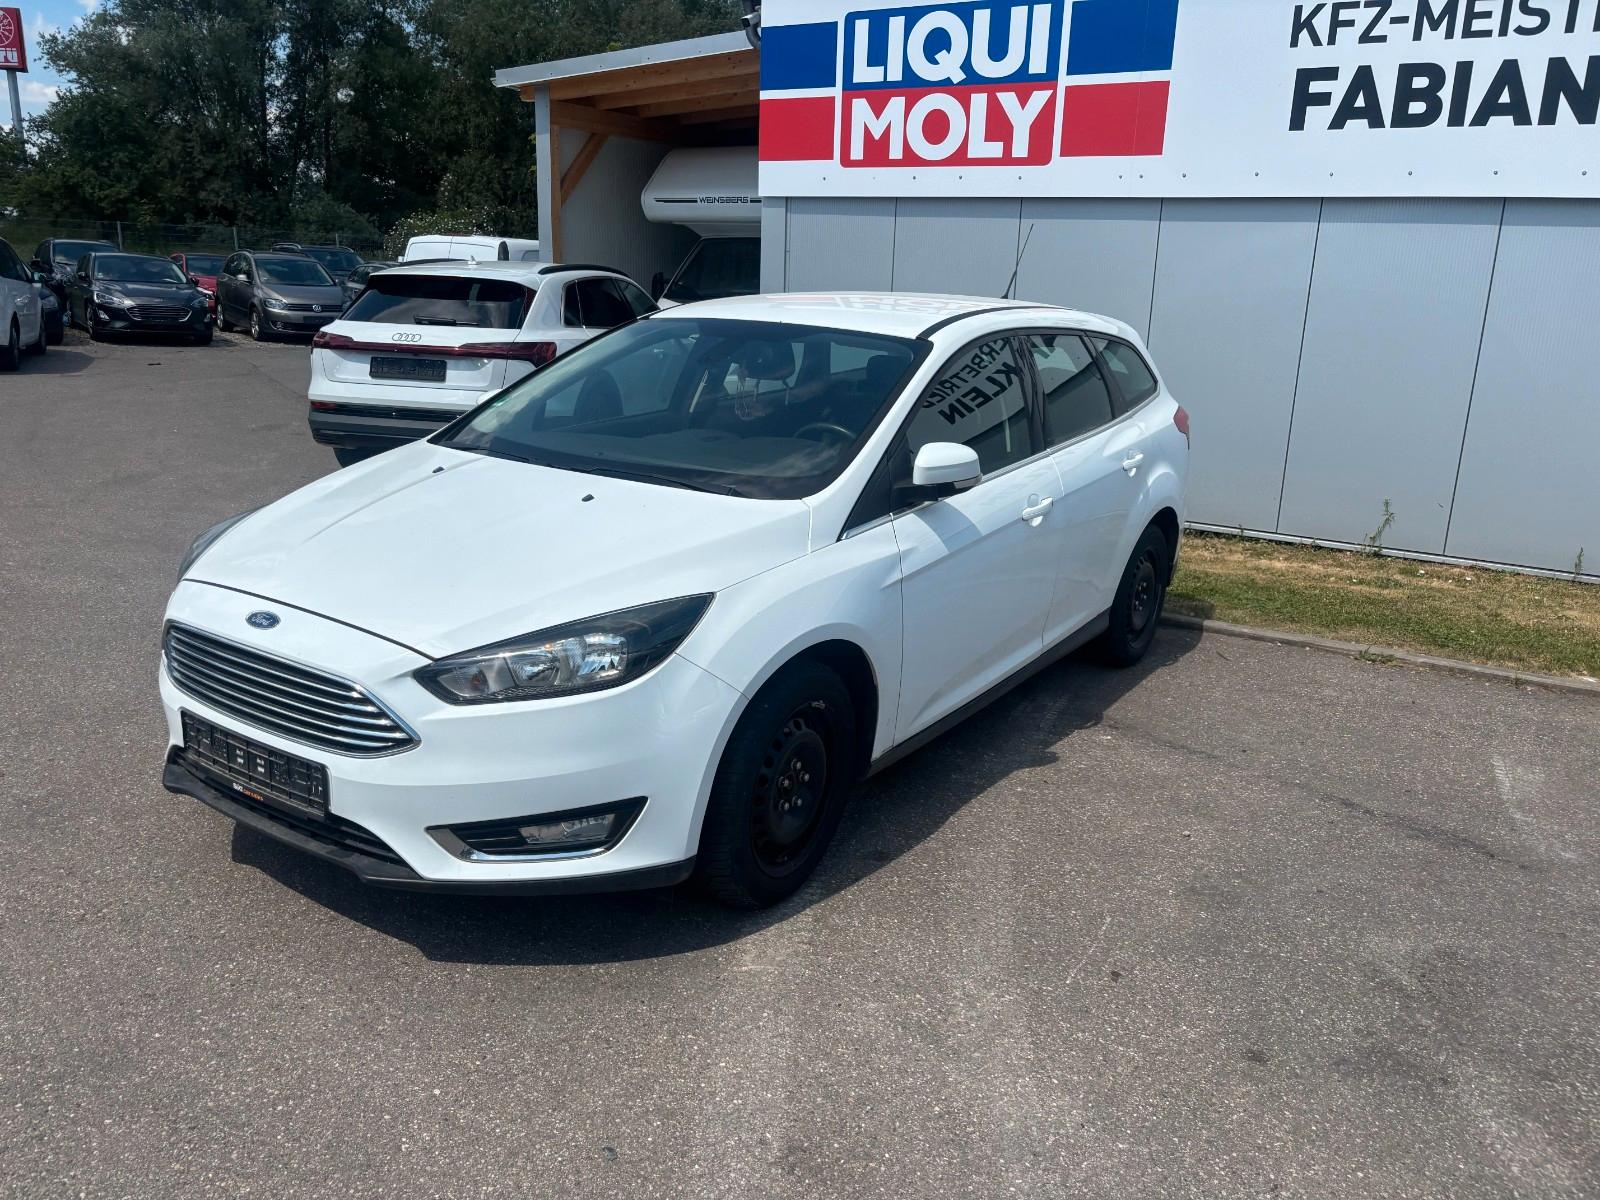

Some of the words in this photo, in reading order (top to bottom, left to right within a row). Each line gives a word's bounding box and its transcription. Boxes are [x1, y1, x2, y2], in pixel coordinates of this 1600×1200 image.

[852, 3, 1052, 85] LIQUI
[1289, 0, 1600, 48] KFZ-MEIST
[850, 90, 1054, 161] MOLY
[1288, 55, 1600, 131] FABIAN
[698, 196, 749, 204] WEINSBERG
